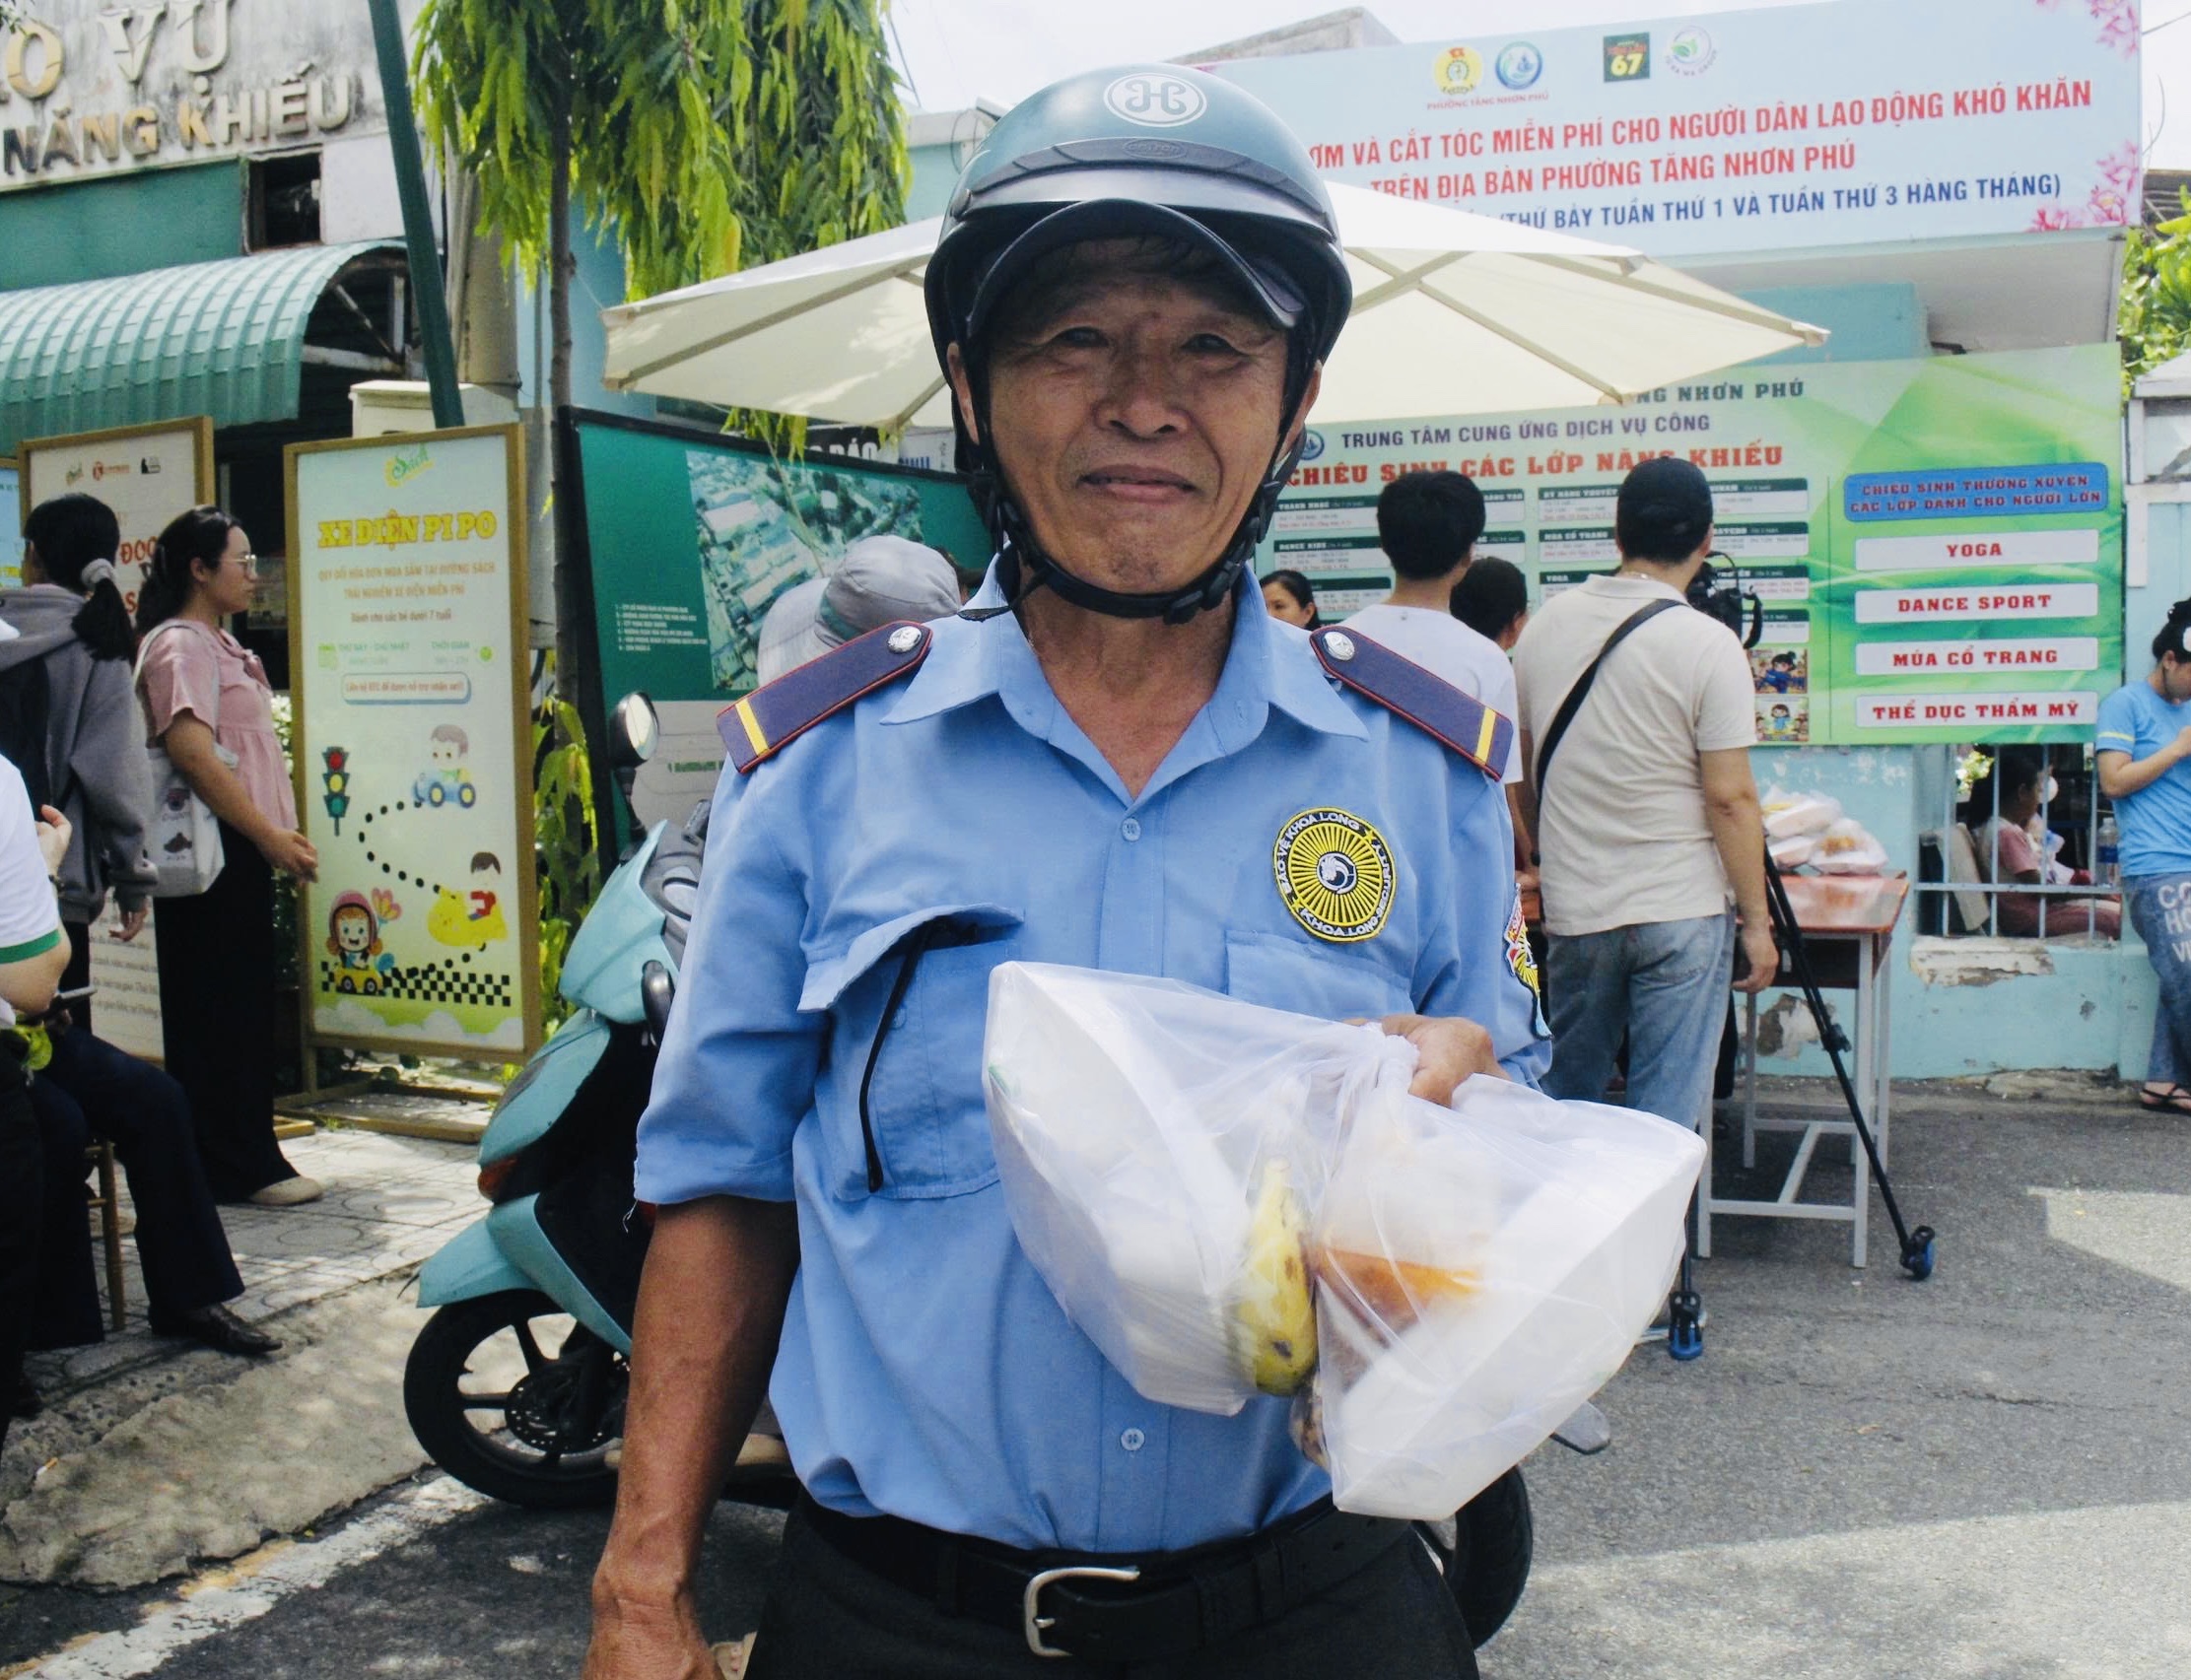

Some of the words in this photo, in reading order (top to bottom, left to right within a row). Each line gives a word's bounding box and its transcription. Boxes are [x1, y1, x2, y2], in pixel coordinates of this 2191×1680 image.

[1610, 52, 1644, 77] 67
[3, 105, 162, 174] NĂNG
[177, 61, 351, 150] KHIẾU
[1352, 136, 1381, 166] VÀ
[1390, 128, 1431, 163] CẮT
[1440, 128, 1483, 158] TÓC
[1493, 118, 1553, 154] MIỄN
[1563, 114, 1603, 149] PHÍ
[1611, 117, 1660, 145] CHO
[1670, 102, 1746, 141] NGƯỜI
[1755, 101, 1808, 133] DÂN
[1817, 100, 1865, 129] LAO
[1872, 91, 1944, 128] ĐỘNG
[1953, 82, 2007, 116] KHÓ
[2017, 75, 2091, 112] KHĂN
[1437, 173, 1476, 204] ĐỊA
[1484, 165, 1534, 195] BÀN
[1541, 159, 1641, 191] PHƯỜNG
[1650, 151, 1715, 184] TĂNG
[1724, 147, 1795, 178] NHƠN
[1804, 138, 1855, 170] PHÚ
[1601, 197, 1654, 226] TUẦN
[1664, 195, 1704, 221] THỨ
[1714, 199, 1723, 218] 1
[1734, 192, 1760, 217] VÀ
[1769, 183, 1824, 214] TUẦN
[1833, 182, 1876, 209] THỨ
[1885, 185, 1898, 206] 3
[1907, 177, 1967, 205] HÀNG
[1976, 171, 2061, 201] THÁNG)
[1678, 382, 1744, 402] NHƠN
[1755, 377, 1804, 398] PHÚ
[1341, 430, 1404, 448] TRUNG
[1410, 425, 1451, 444] TÂM
[1459, 424, 1511, 442] CUNG
[1519, 419, 1557, 439] ỨNG
[1566, 419, 1613, 439] DỊCH
[1621, 417, 1647, 437] VỤ
[1655, 412, 1710, 432] CÔNG
[1461, 453, 1515, 477] CÁC
[1527, 449, 1584, 475] LỚP
[1689, 439, 1783, 467] KHIẾU
[1946, 542, 2003, 558] YOGA
[1897, 597, 1968, 612] DANCE
[1978, 594, 2052, 610] SPORT
[1892, 648, 1938, 667] MÚA
[1948, 643, 1974, 666] CỔ
[1983, 649, 2059, 665] TRANG
[1872, 698, 1916, 720] THỂ
[1924, 705, 1966, 722] DỤC
[1975, 697, 2038, 718] THẨM
[2047, 698, 2080, 717] MỸ
[1285, 813, 1318, 839] KHOA
[1319, 812, 1360, 831] LONG
[1300, 907, 1345, 936] KHOA
